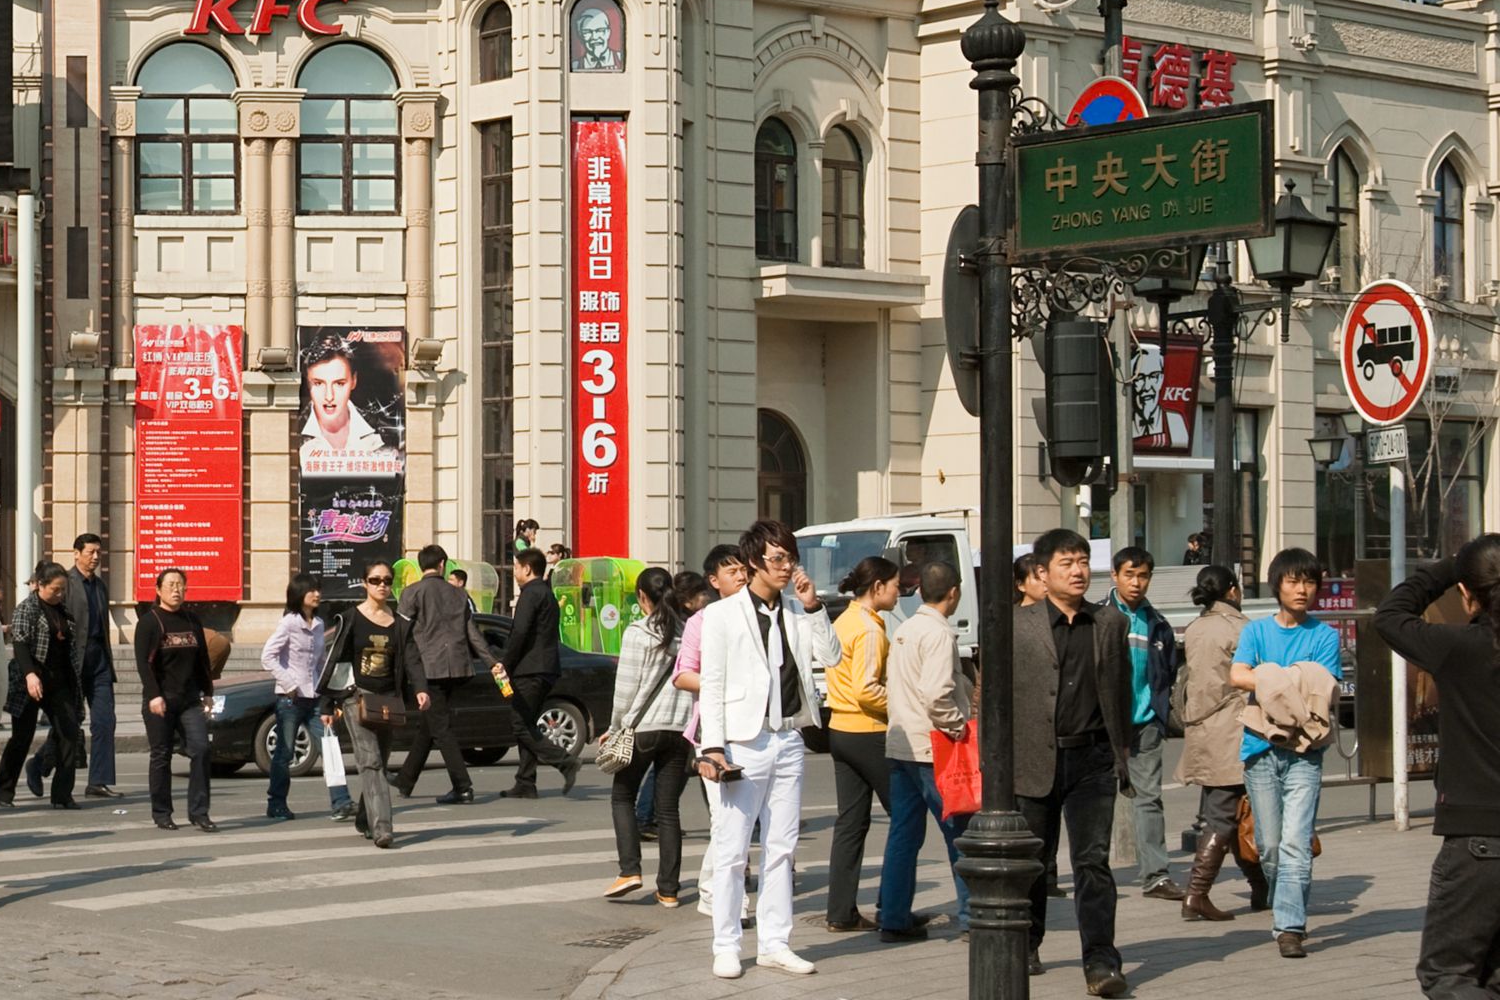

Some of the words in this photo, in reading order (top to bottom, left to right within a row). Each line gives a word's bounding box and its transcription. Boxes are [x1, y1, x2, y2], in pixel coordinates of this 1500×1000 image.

[1045, 139, 1231, 203] 中央大街
[587, 156, 613, 280] 非常折扣日
[1052, 210, 1102, 231] ZHONG
[1111, 204, 1151, 224] YANG
[1162, 200, 1179, 218] DA
[1189, 197, 1213, 214] JIE
[579, 290, 620, 313] 服饰
[579, 321, 620, 344] 鞋品
[1163, 387, 1192, 401] KFC
